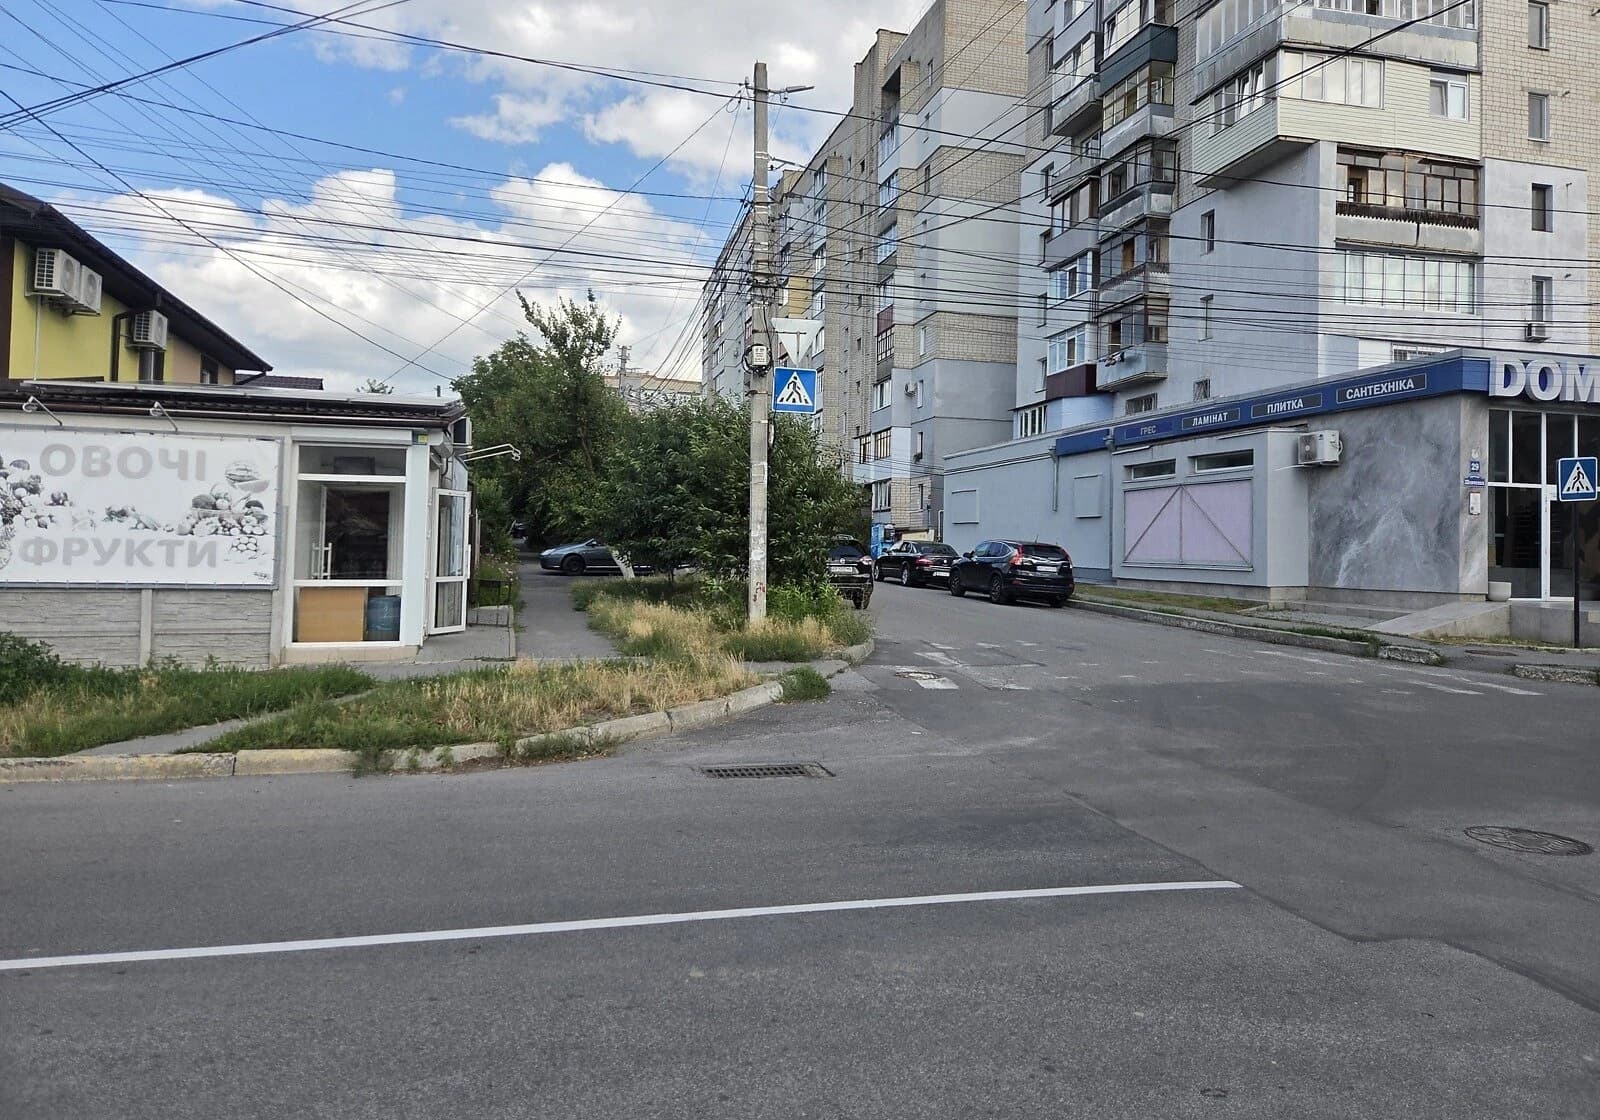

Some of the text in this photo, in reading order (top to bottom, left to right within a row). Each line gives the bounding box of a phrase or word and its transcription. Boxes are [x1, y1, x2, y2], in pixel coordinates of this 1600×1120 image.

[1346, 378, 1415, 400] САНТЕХНІКА
[1489, 356, 1600, 403] DOM
[1266, 398, 1304, 414] ПЛИТКА
[1192, 411, 1229, 427] ЛАМІНАТ
[1140, 426, 1157, 436] ГРЕС
[39, 443, 208, 481] ОВОЧІ
[18, 536, 218, 568] ФРУКТИ
